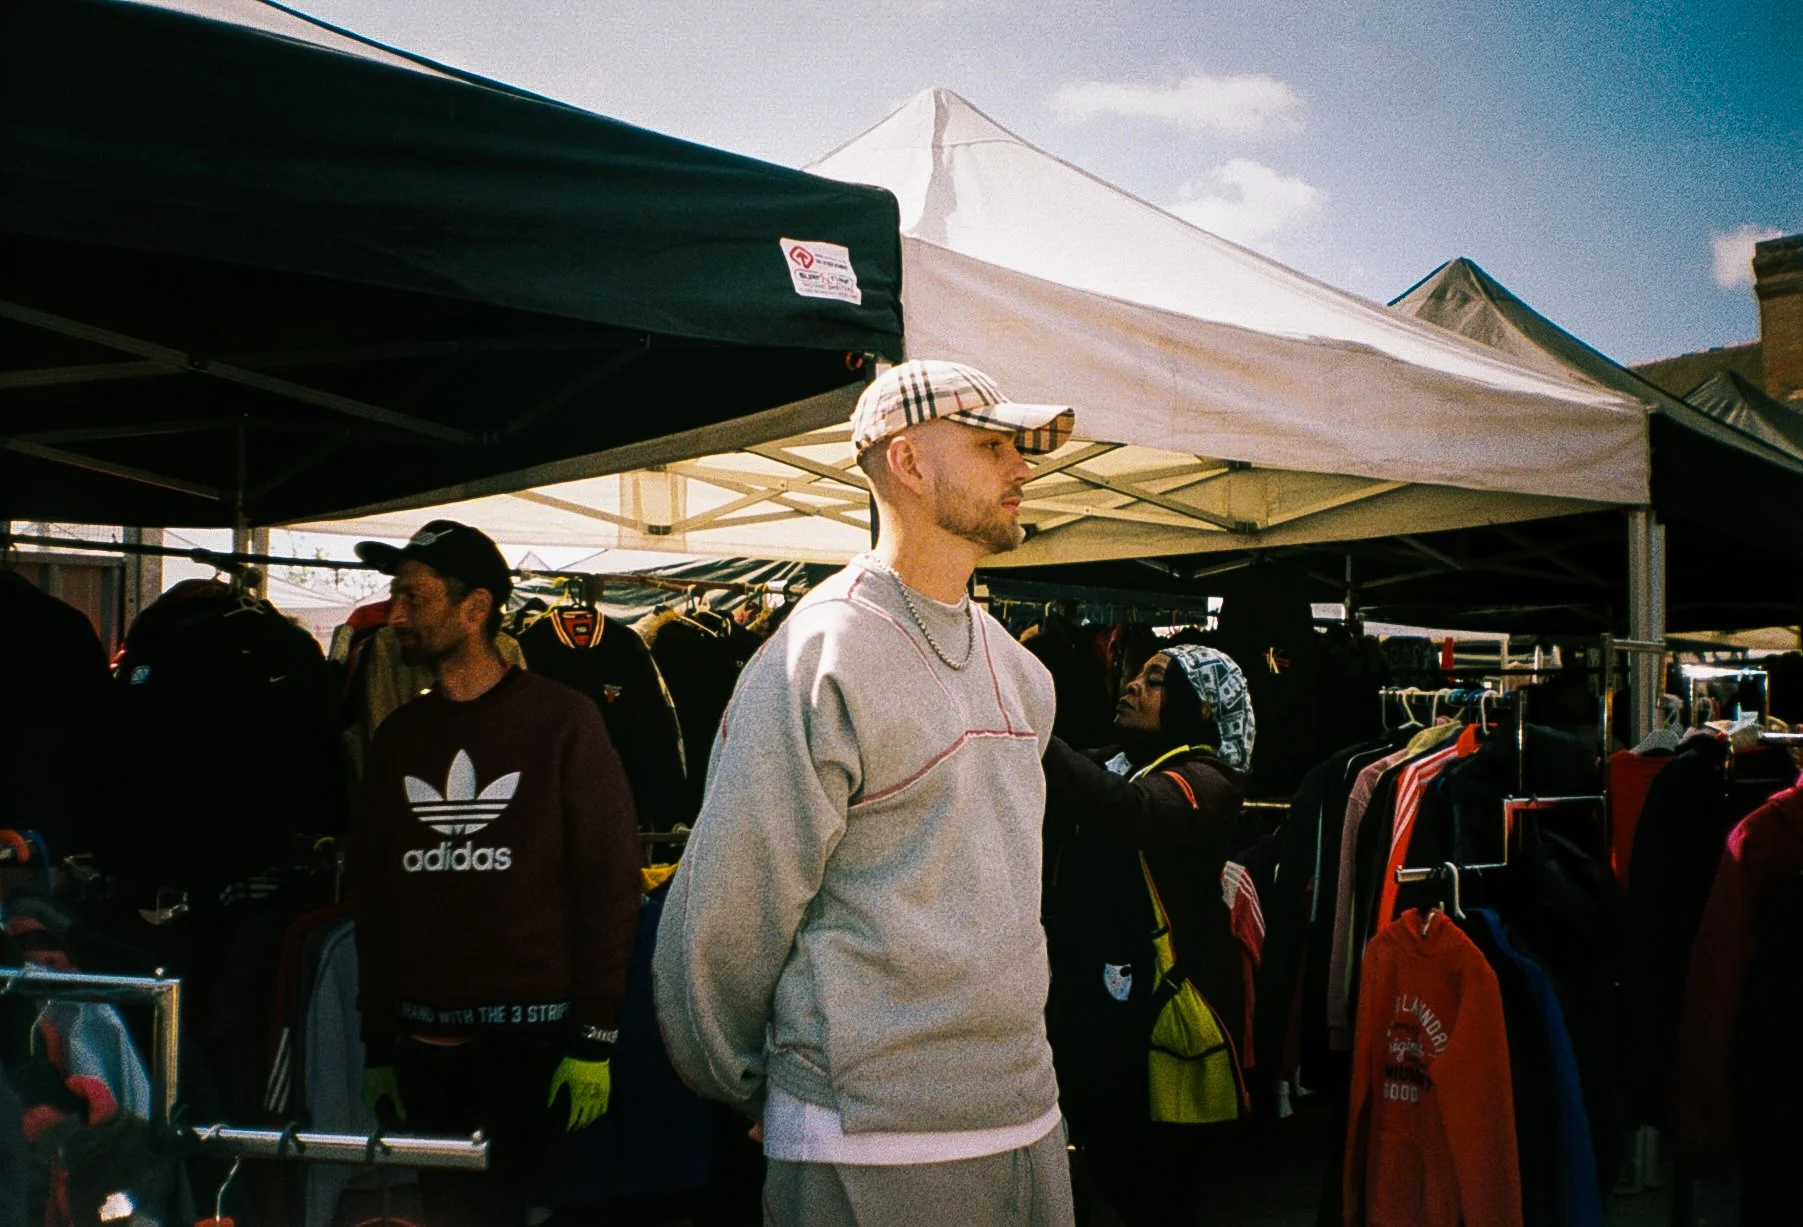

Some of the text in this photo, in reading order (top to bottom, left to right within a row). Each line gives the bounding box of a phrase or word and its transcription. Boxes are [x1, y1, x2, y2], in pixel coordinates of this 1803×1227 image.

[403, 840, 512, 872] adidas
[436, 1009, 474, 1025] WITH
[477, 1004, 506, 1024] THE
[511, 1004, 522, 1023] 3
